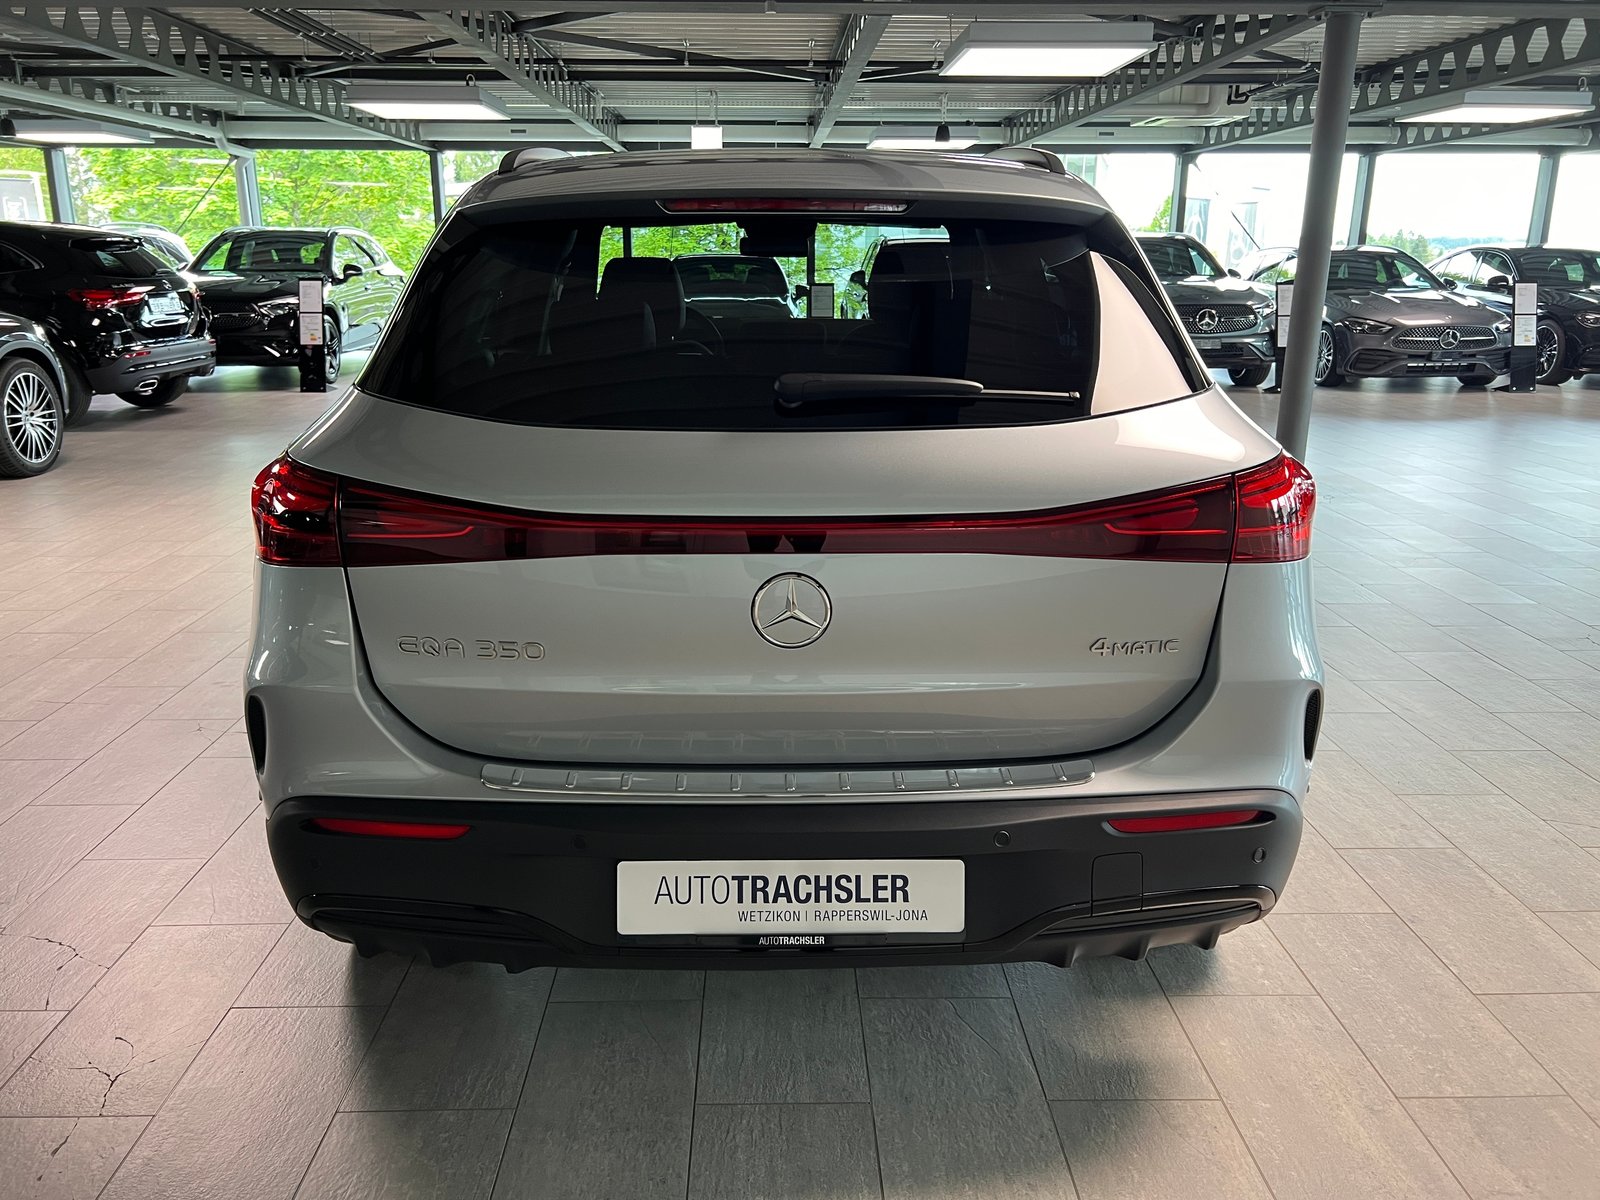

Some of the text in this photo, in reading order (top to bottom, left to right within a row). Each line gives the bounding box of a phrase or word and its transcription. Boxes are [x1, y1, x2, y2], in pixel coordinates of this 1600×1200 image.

[397, 635, 545, 661] EQA 350
[1089, 637, 1180, 656] 4MATIC
[654, 874, 909, 905] AUTOTRACHSLER
[738, 910, 800, 922] WETZIKON
[814, 909, 928, 922] RAPPERSWIL-JONA
[759, 936, 825, 945] AUTOTRACHSLER
